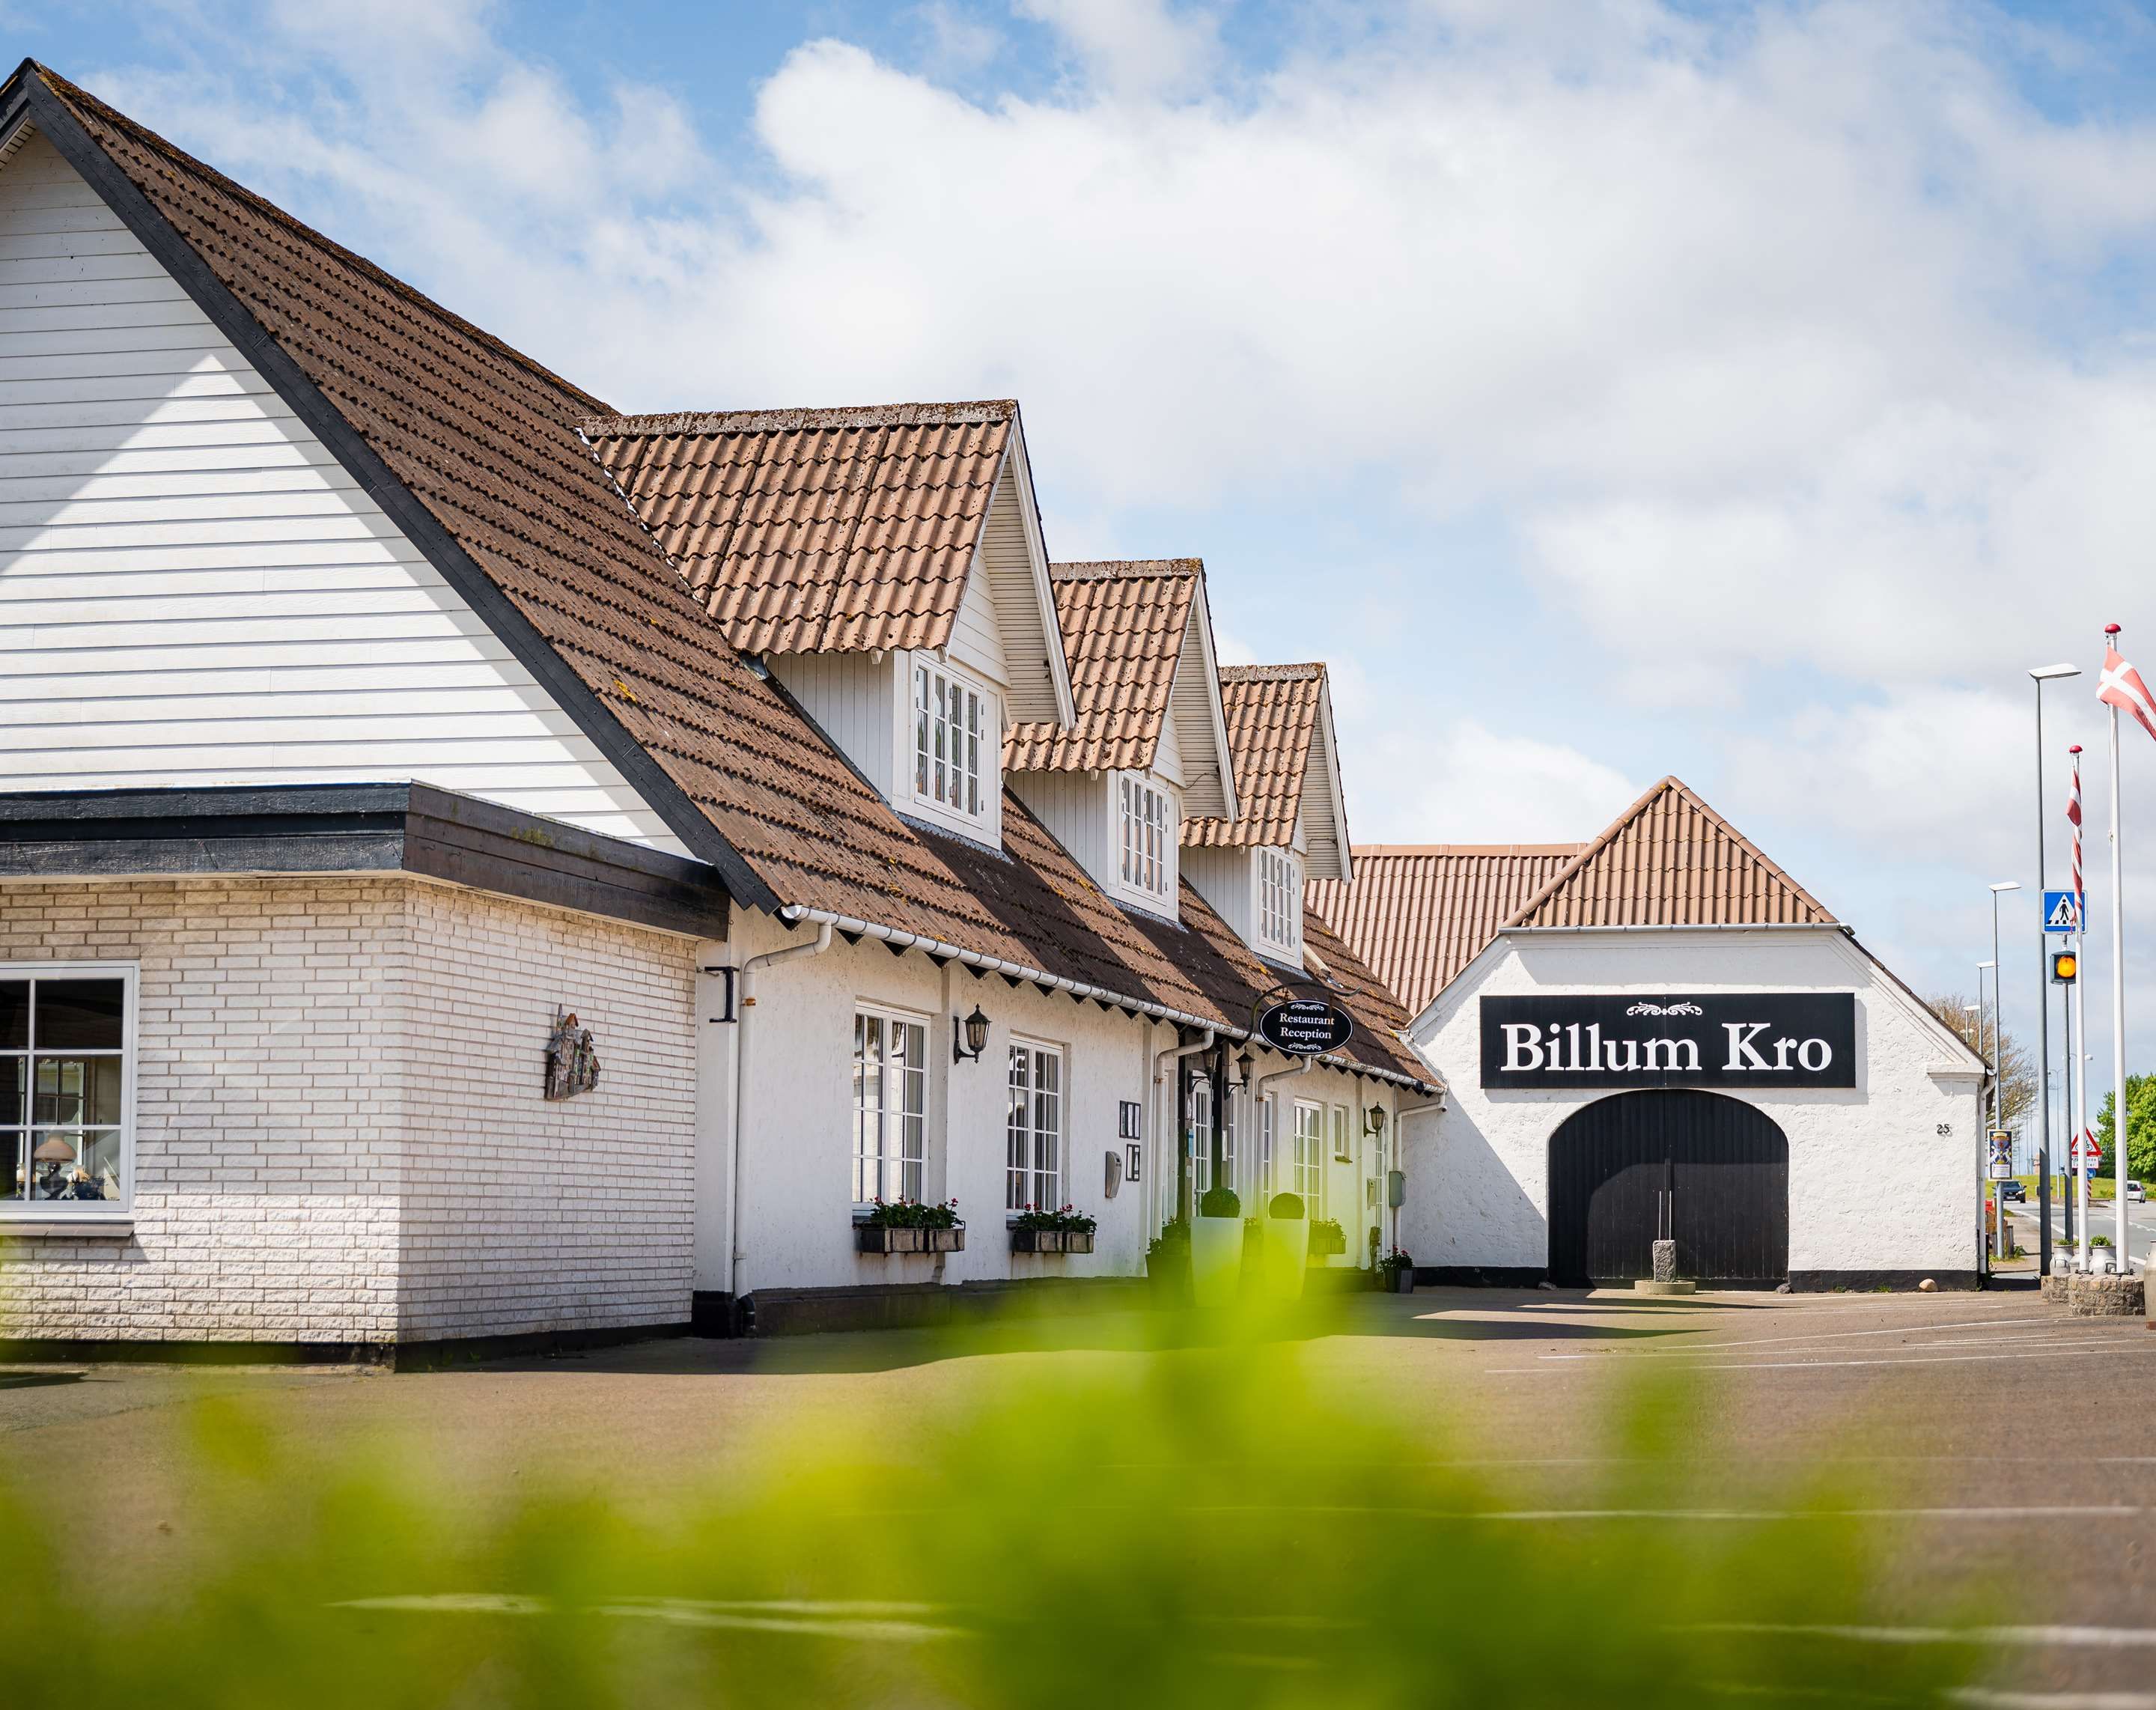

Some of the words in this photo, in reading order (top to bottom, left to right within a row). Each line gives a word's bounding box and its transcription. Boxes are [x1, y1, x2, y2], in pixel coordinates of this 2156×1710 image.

[1279, 1013, 1335, 1025] Restaurant
[1280, 1026, 1332, 1041] Reception
[1500, 1023, 1702, 1071] Billum
[1721, 1023, 1833, 1071] Kro
[1936, 1124, 1950, 1134] 25
